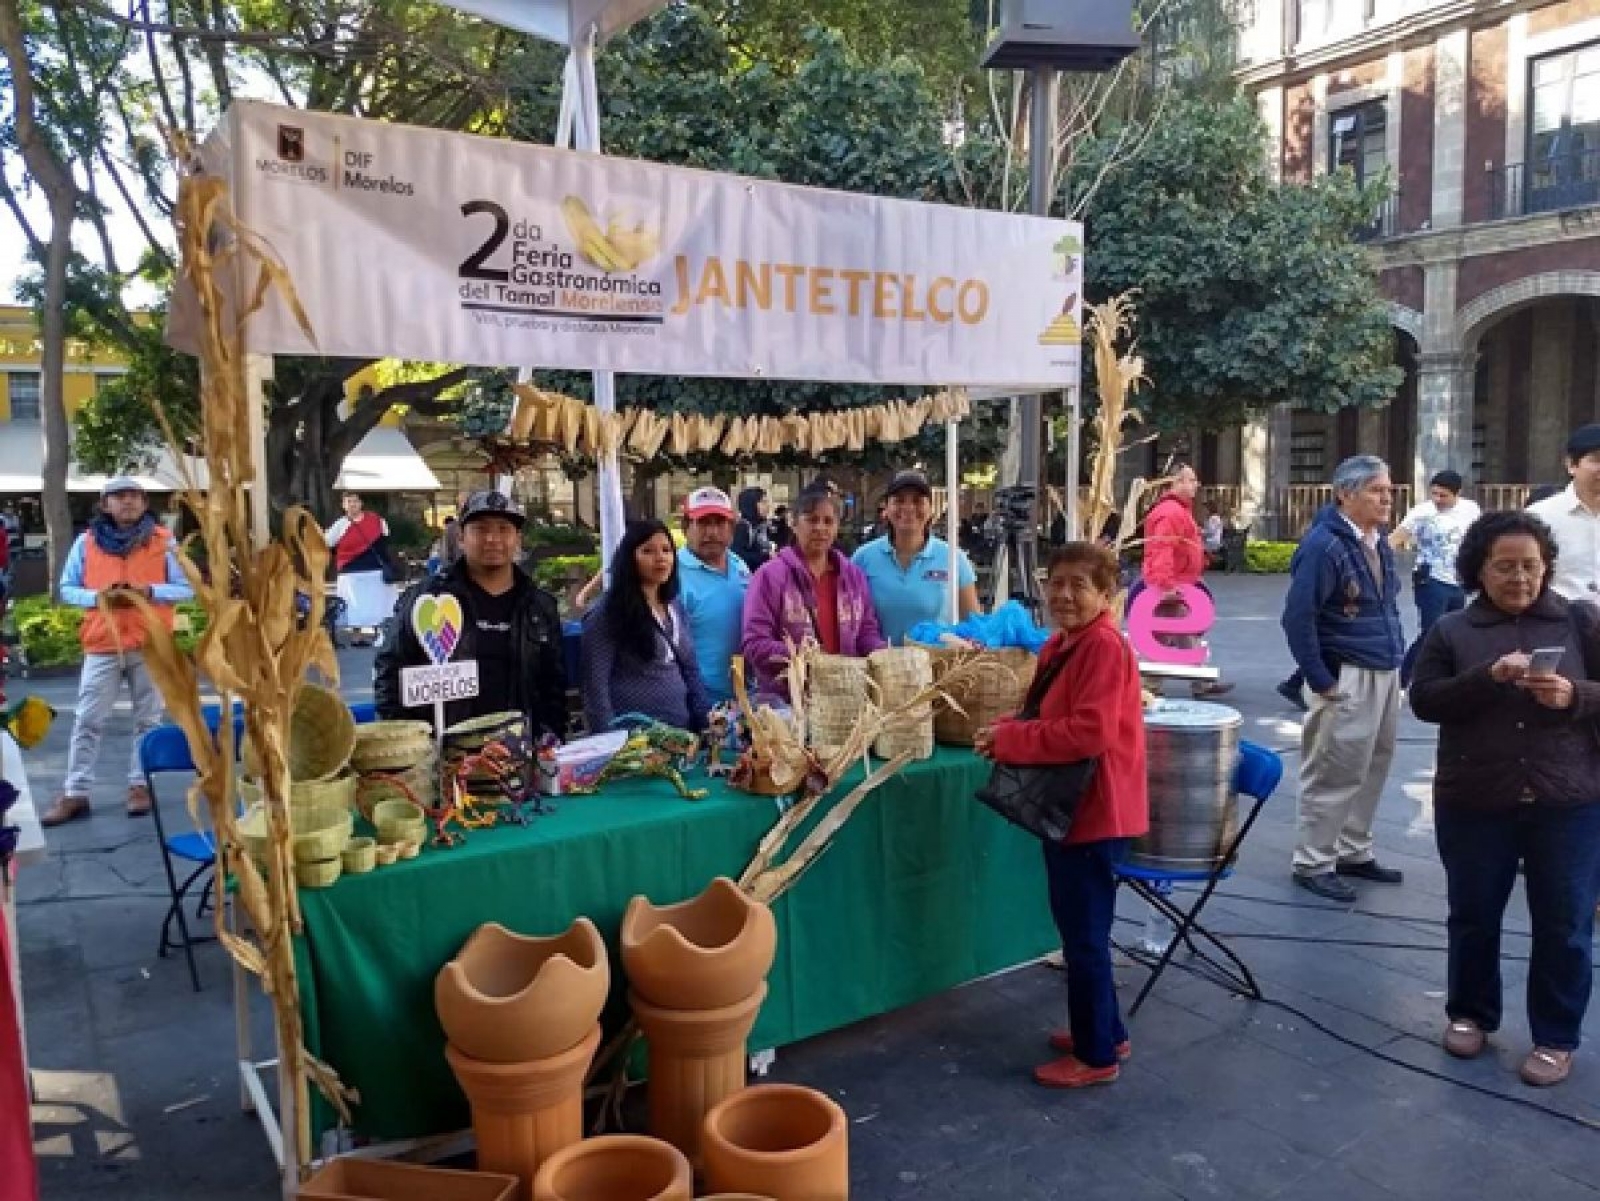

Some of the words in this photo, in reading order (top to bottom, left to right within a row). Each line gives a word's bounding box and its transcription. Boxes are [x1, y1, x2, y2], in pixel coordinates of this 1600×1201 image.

[344, 151, 374, 169] DIF
[344, 170, 414, 197] Morelos
[459, 200, 509, 280] 2
[512, 240, 573, 270] Feria
[511, 263, 661, 296] Gastronómica
[671, 254, 989, 324] JANTETELCO
[459, 282, 490, 299] del
[495, 284, 556, 308] Tamal
[407, 676, 478, 703] MORELOS
